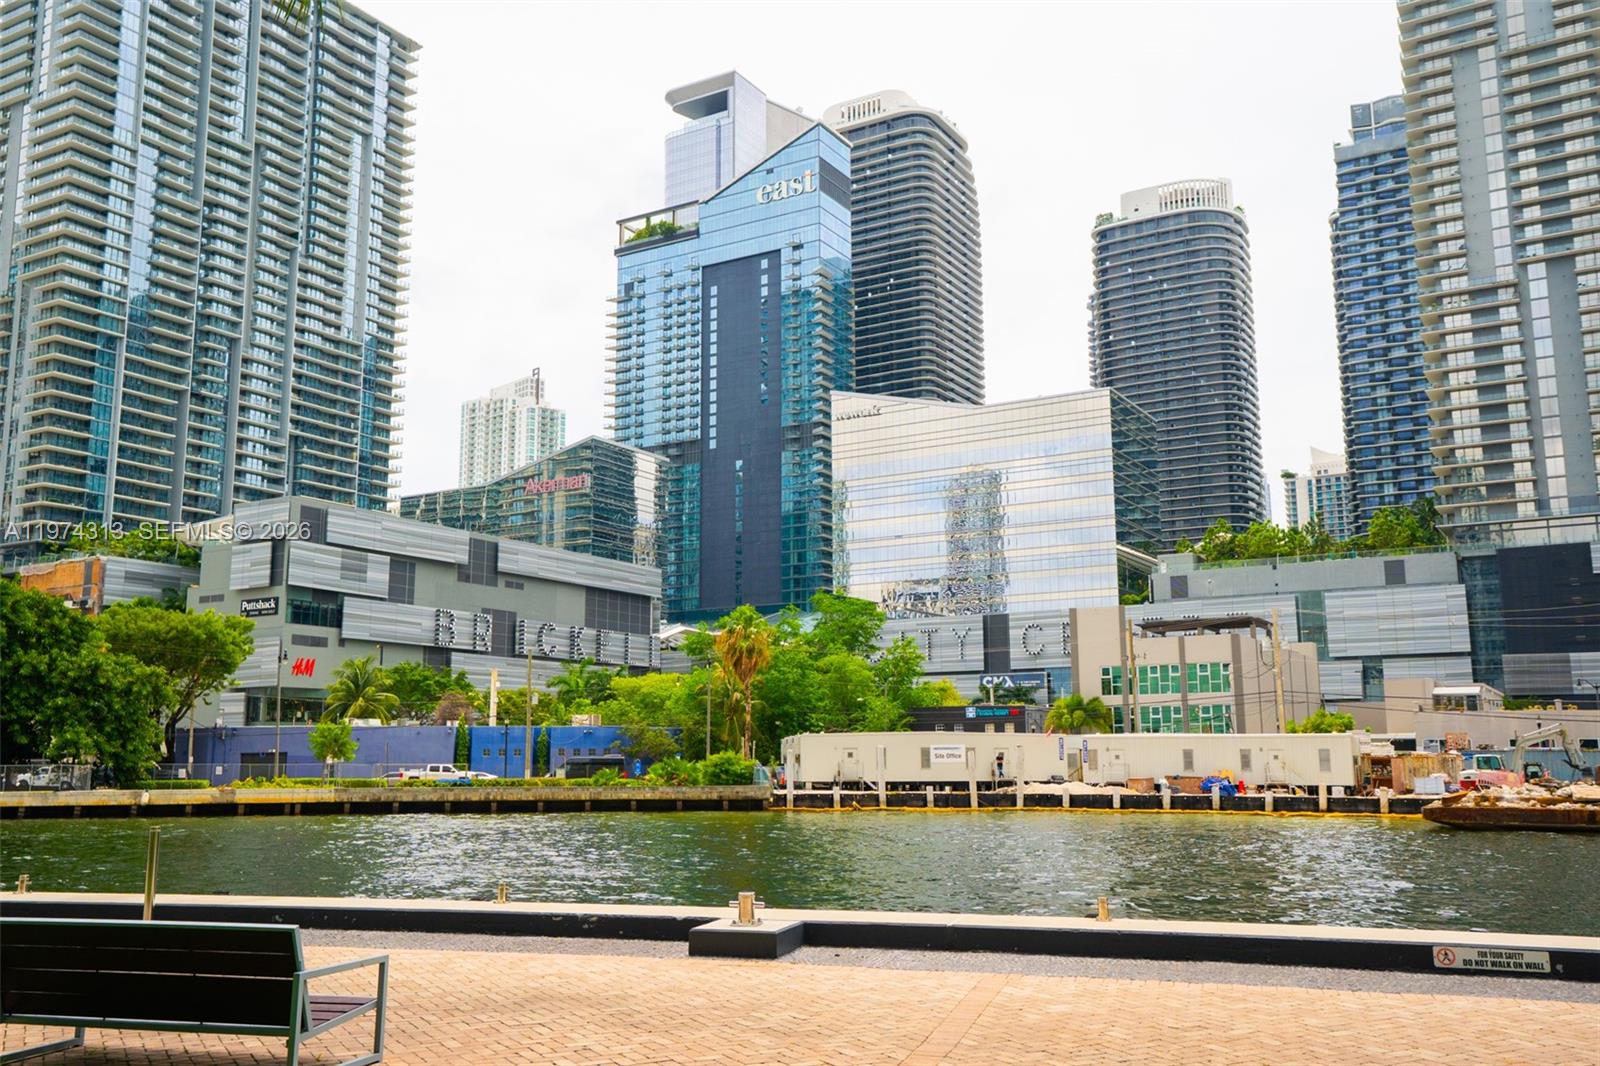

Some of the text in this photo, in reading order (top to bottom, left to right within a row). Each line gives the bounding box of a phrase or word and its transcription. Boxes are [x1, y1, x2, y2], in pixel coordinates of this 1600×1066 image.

[756, 169, 817, 204] east
[524, 472, 591, 495] Akerman
[241, 598, 276, 611] Puttshack
[434, 608, 662, 668] BRICKELL
[290, 657, 316, 678] H&M
[1462, 958, 1545, 970] DO NOT WALK ON WALL
[1477, 950, 1524, 960] FOR YOUR SAFETY
